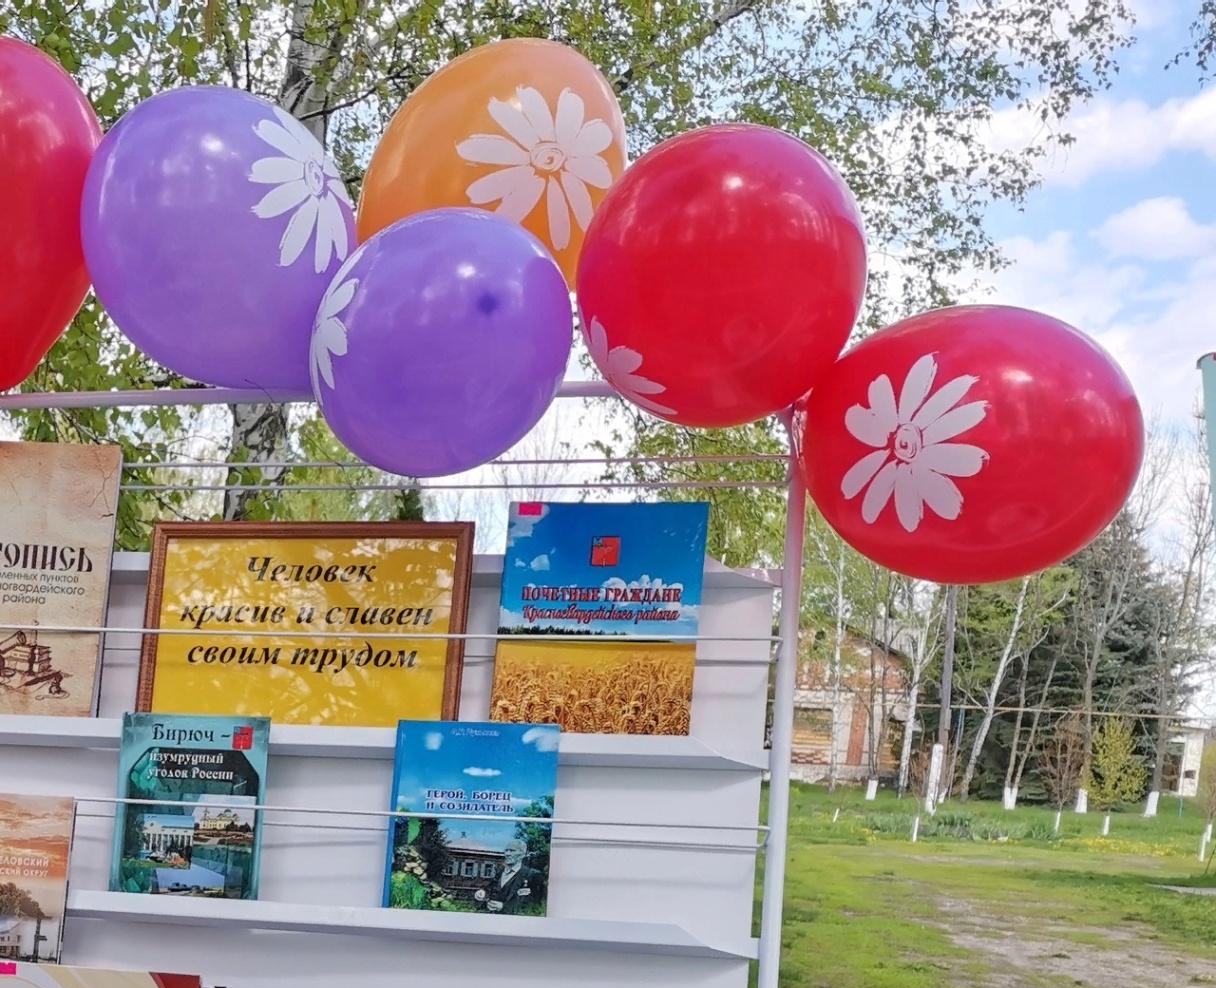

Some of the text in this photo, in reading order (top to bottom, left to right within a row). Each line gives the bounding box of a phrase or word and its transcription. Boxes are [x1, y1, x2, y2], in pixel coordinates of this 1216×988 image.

[247, 556, 376, 583] Человек
[40, 573, 79, 585] пунктов
[2, 592, 46, 605] района
[522, 586, 682, 604] ПОЧЕТНЫЕ ГРАЖДАНЕ
[179, 603, 433, 630] красив и славен
[522, 603, 681, 624] Красногвардейского района
[187, 641, 418, 674] своим трудом
[152, 723, 214, 745] Бирюч
[149, 750, 225, 766] изумрудный
[147, 767, 234, 781] уголок России
[472, 790, 512, 803] БОРЕЦ
[425, 801, 514, 814] И СОЗИДАТЕЛЬ
[23, 868, 49, 877] ОКРУГ
